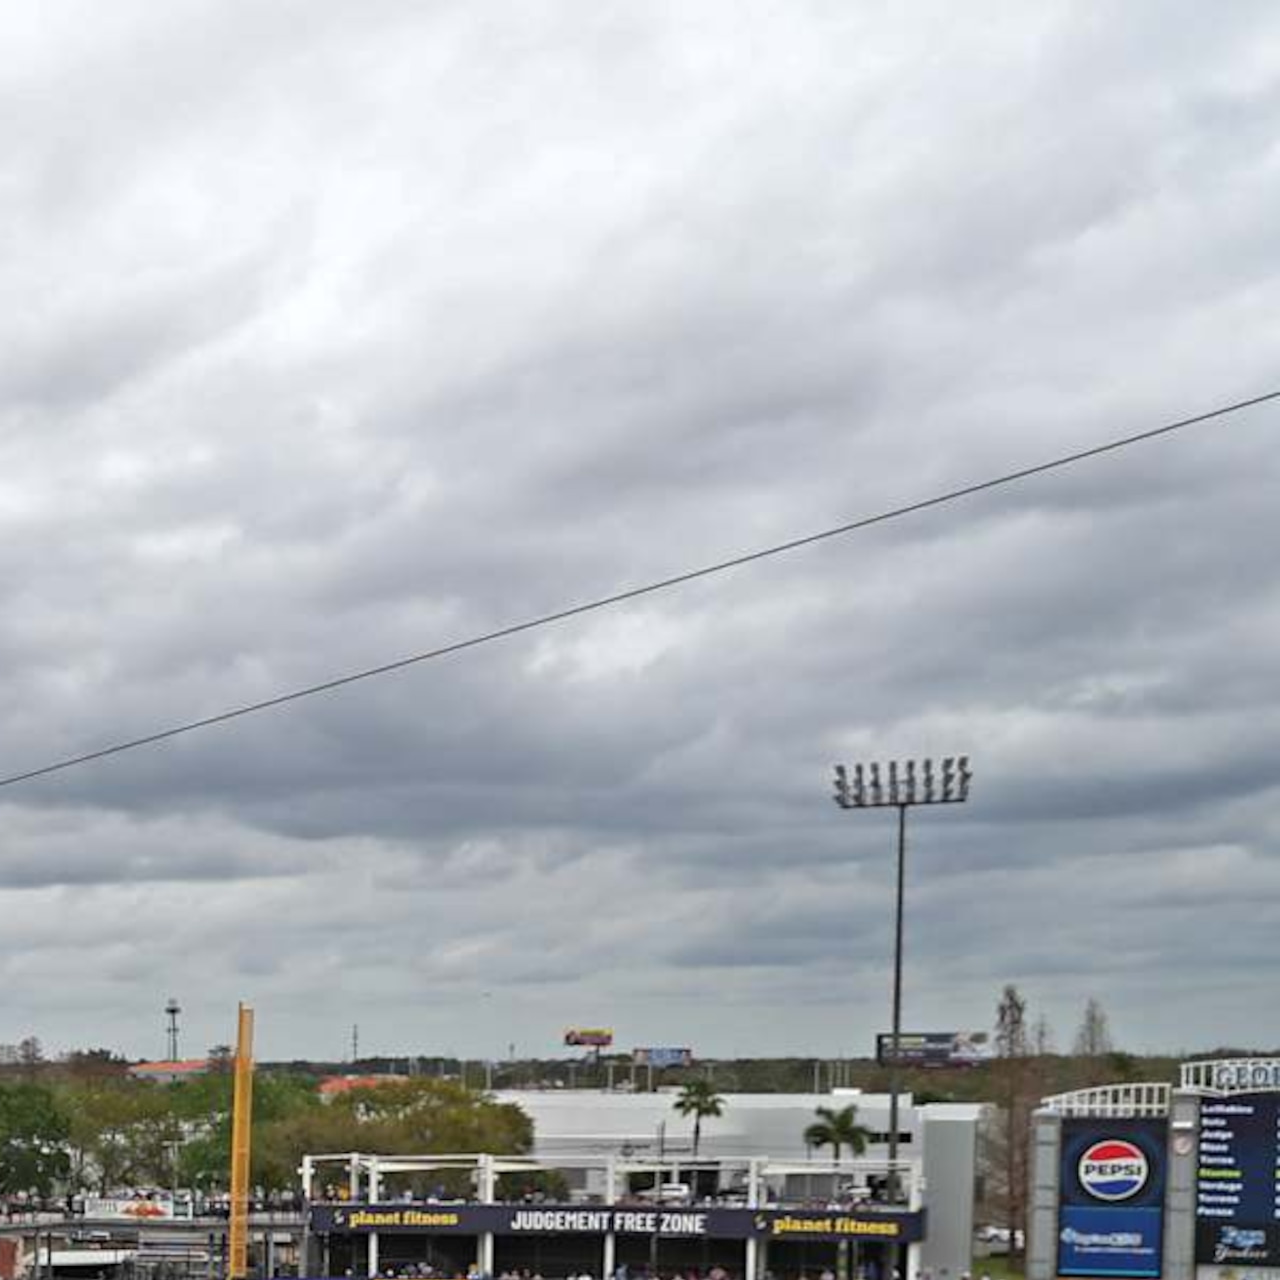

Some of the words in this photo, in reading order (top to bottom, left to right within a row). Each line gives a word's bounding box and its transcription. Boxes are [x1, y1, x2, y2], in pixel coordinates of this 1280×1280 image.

[1083, 1164, 1142, 1177] PEPSI
[349, 1210, 401, 1228] planet
[402, 1210, 459, 1226] fitness
[510, 1210, 609, 1231] JUDGEMENT
[614, 1212, 657, 1233] FREE
[659, 1212, 707, 1234] ZONE
[772, 1216, 832, 1235] planet
[834, 1216, 899, 1236] fitness
